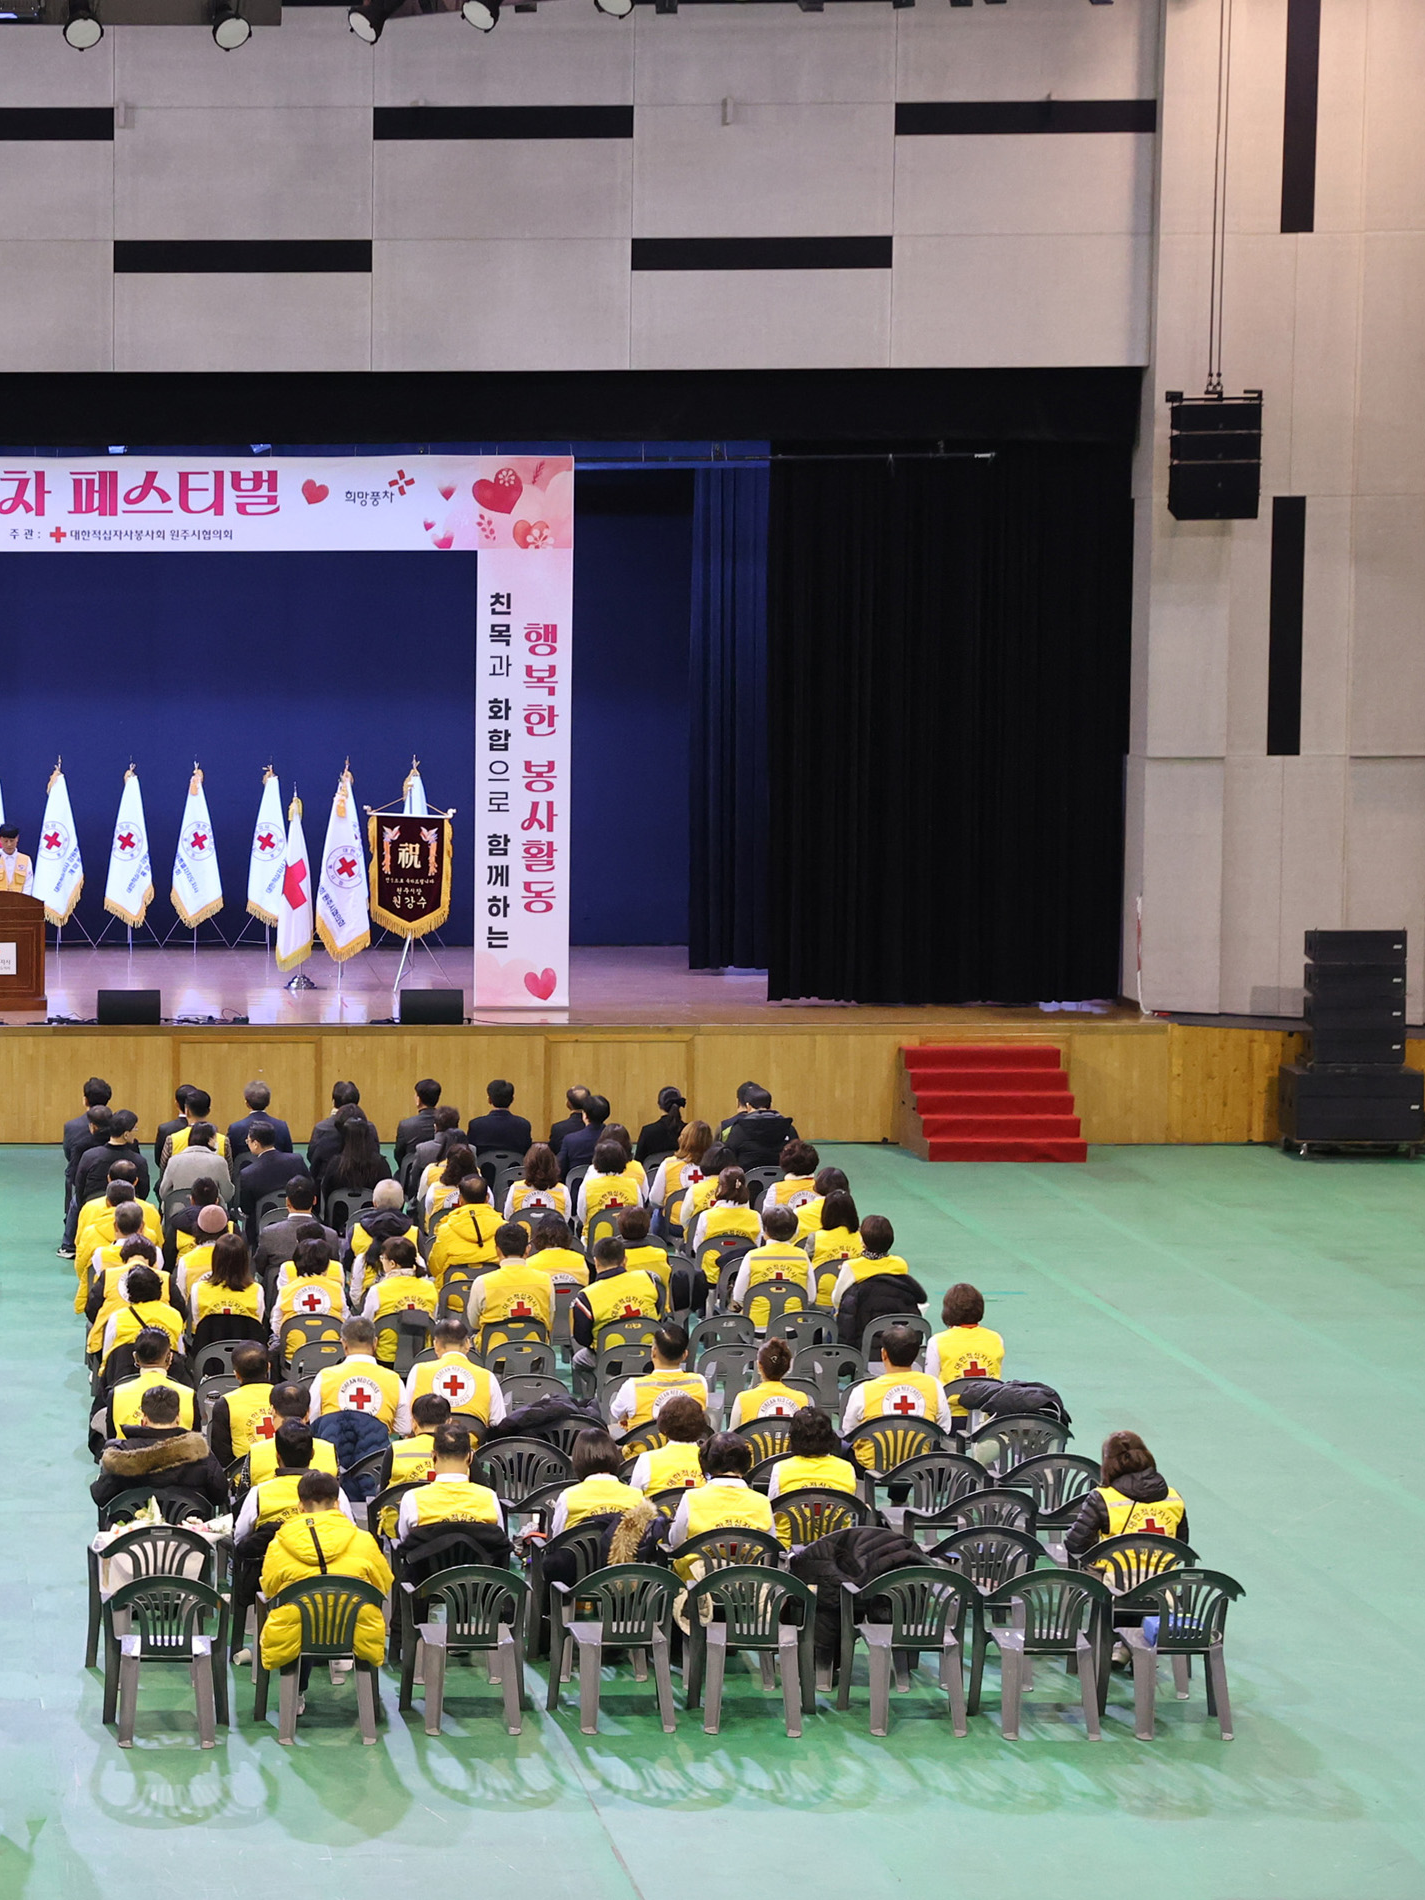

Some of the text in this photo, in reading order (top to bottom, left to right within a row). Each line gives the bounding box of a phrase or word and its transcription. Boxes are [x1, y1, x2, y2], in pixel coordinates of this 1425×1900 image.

[67, 469, 280, 517] 페스티벌
[345, 490, 395, 504] 희망풍차
[70, 529, 165, 540] 대한적십자사봉사회
[170, 529, 233, 540] 원주시협의회
[487, 592, 512, 949] 친목과 화합으로 함께하는
[521, 623, 559, 914] 행복한 봉사활동
[397, 842, 422, 869] 祝
[393, 895, 427, 909] 원강수
[504, 1294, 537, 1310] 대한적십자사
[955, 1353, 992, 1369] 대한적십자사
[341, 1378, 356, 1393] KOREAN
[367, 1379, 380, 1393] CROSS
[667, 1470, 706, 1487] 대한적십자
[1128, 1508, 1172, 1529] 대한적십자사
